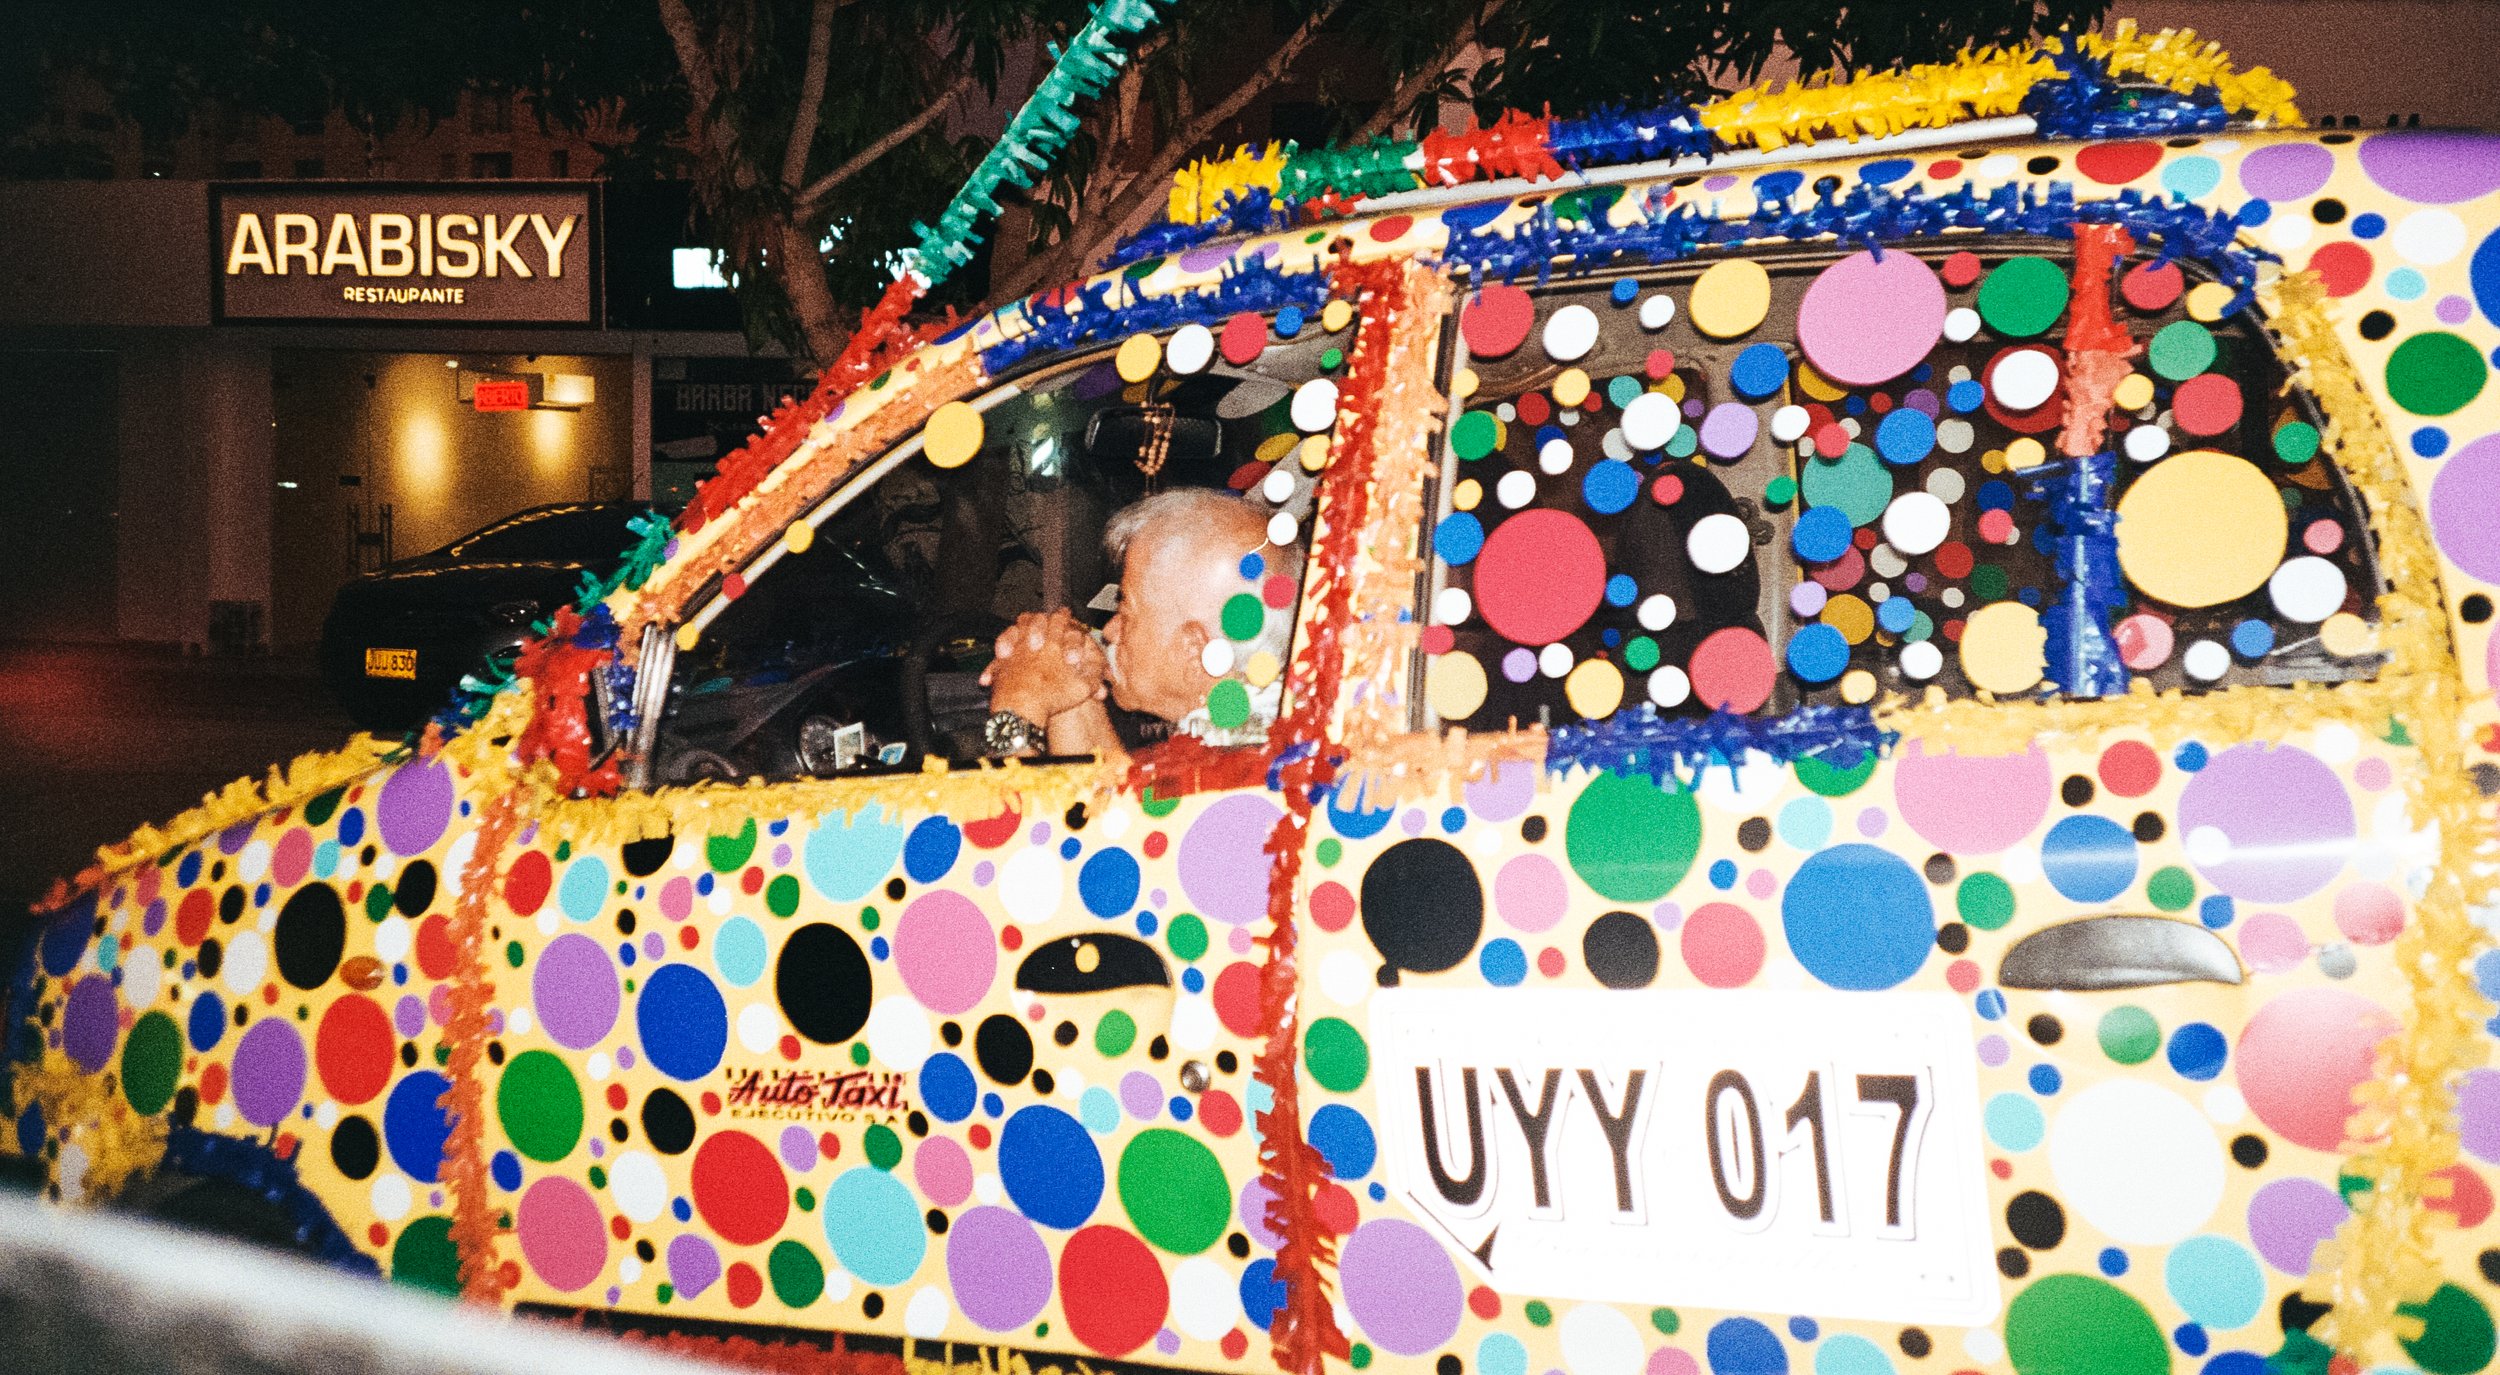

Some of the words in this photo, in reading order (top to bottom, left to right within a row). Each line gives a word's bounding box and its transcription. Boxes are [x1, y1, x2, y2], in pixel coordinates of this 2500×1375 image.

[226, 212, 579, 278] ARABISKY
[675, 383, 753, 412] BARBA
[728, 1070, 820, 1106] Auto
[731, 1109, 855, 1123] EJECUTIVO
[1414, 1066, 1648, 1213] UYY
[1704, 1068, 1920, 1228] 017
